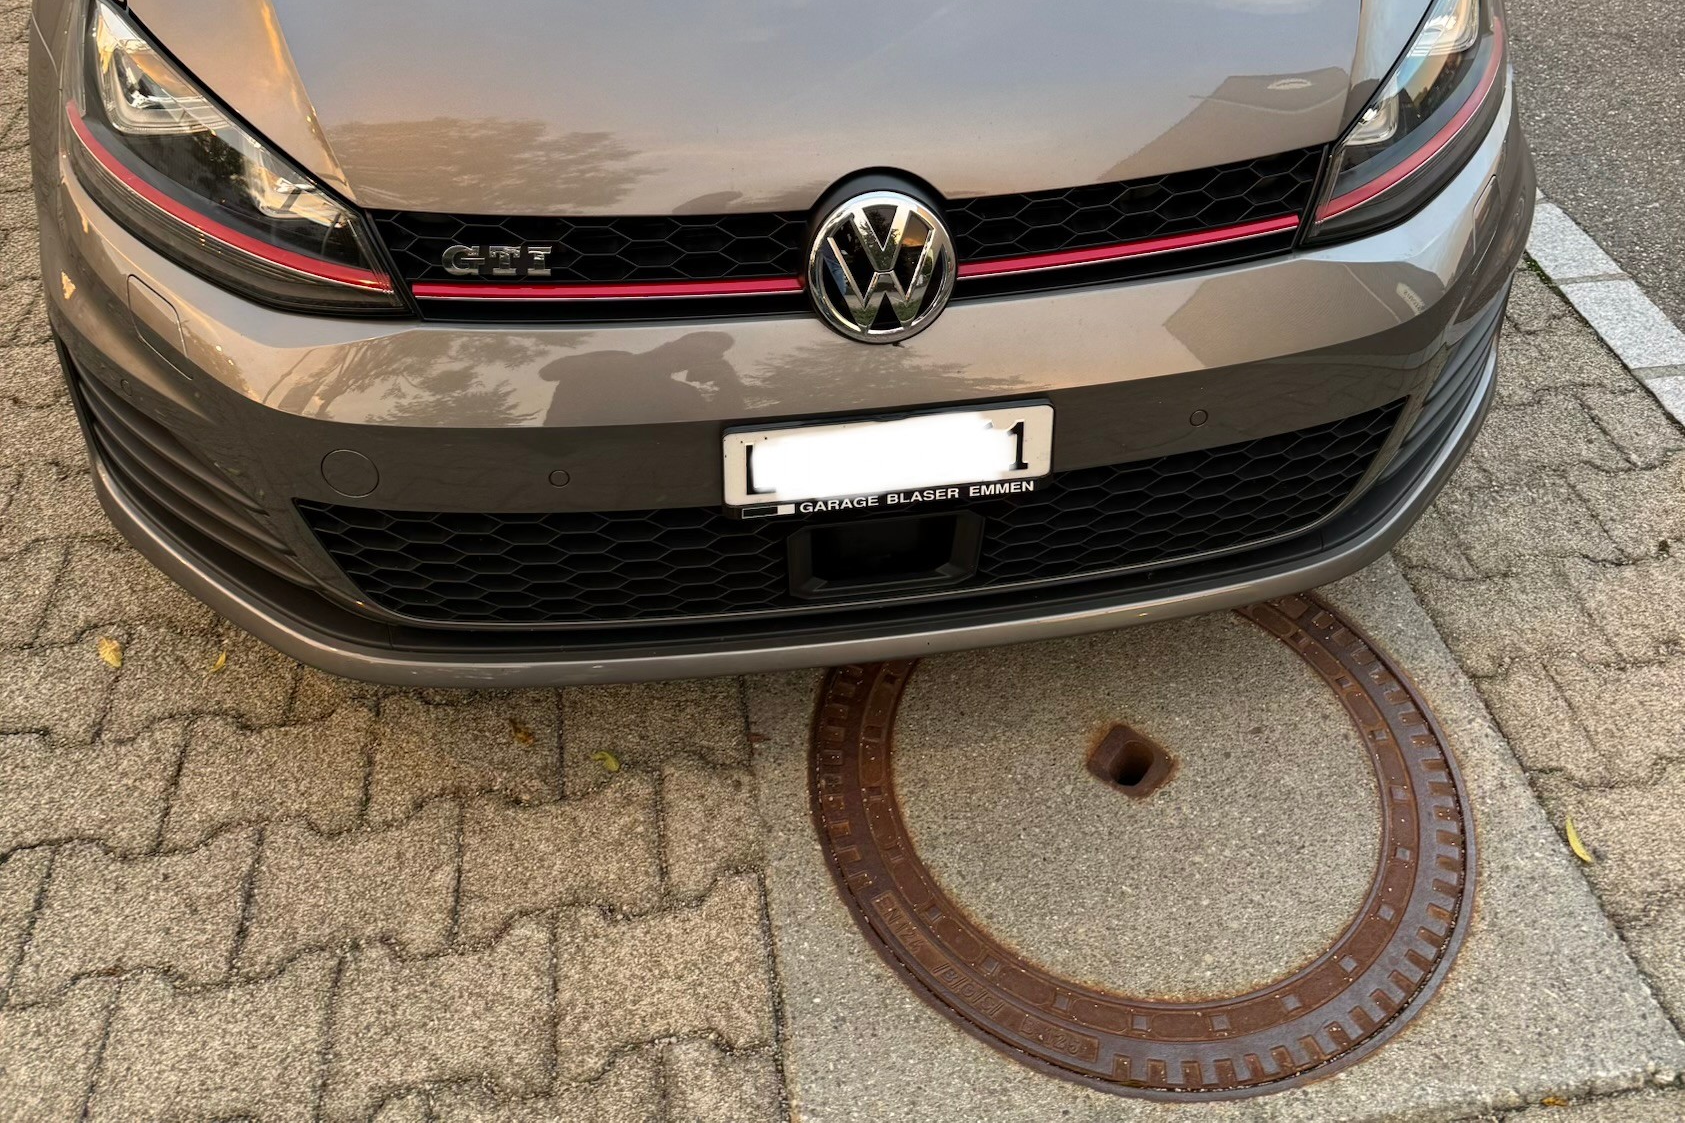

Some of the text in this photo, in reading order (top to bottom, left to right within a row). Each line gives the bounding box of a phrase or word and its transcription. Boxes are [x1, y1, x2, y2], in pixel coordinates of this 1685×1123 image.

[441, 245, 552, 276] GTI
[800, 480, 1035, 514] GARAGE BLASER EMMEN
